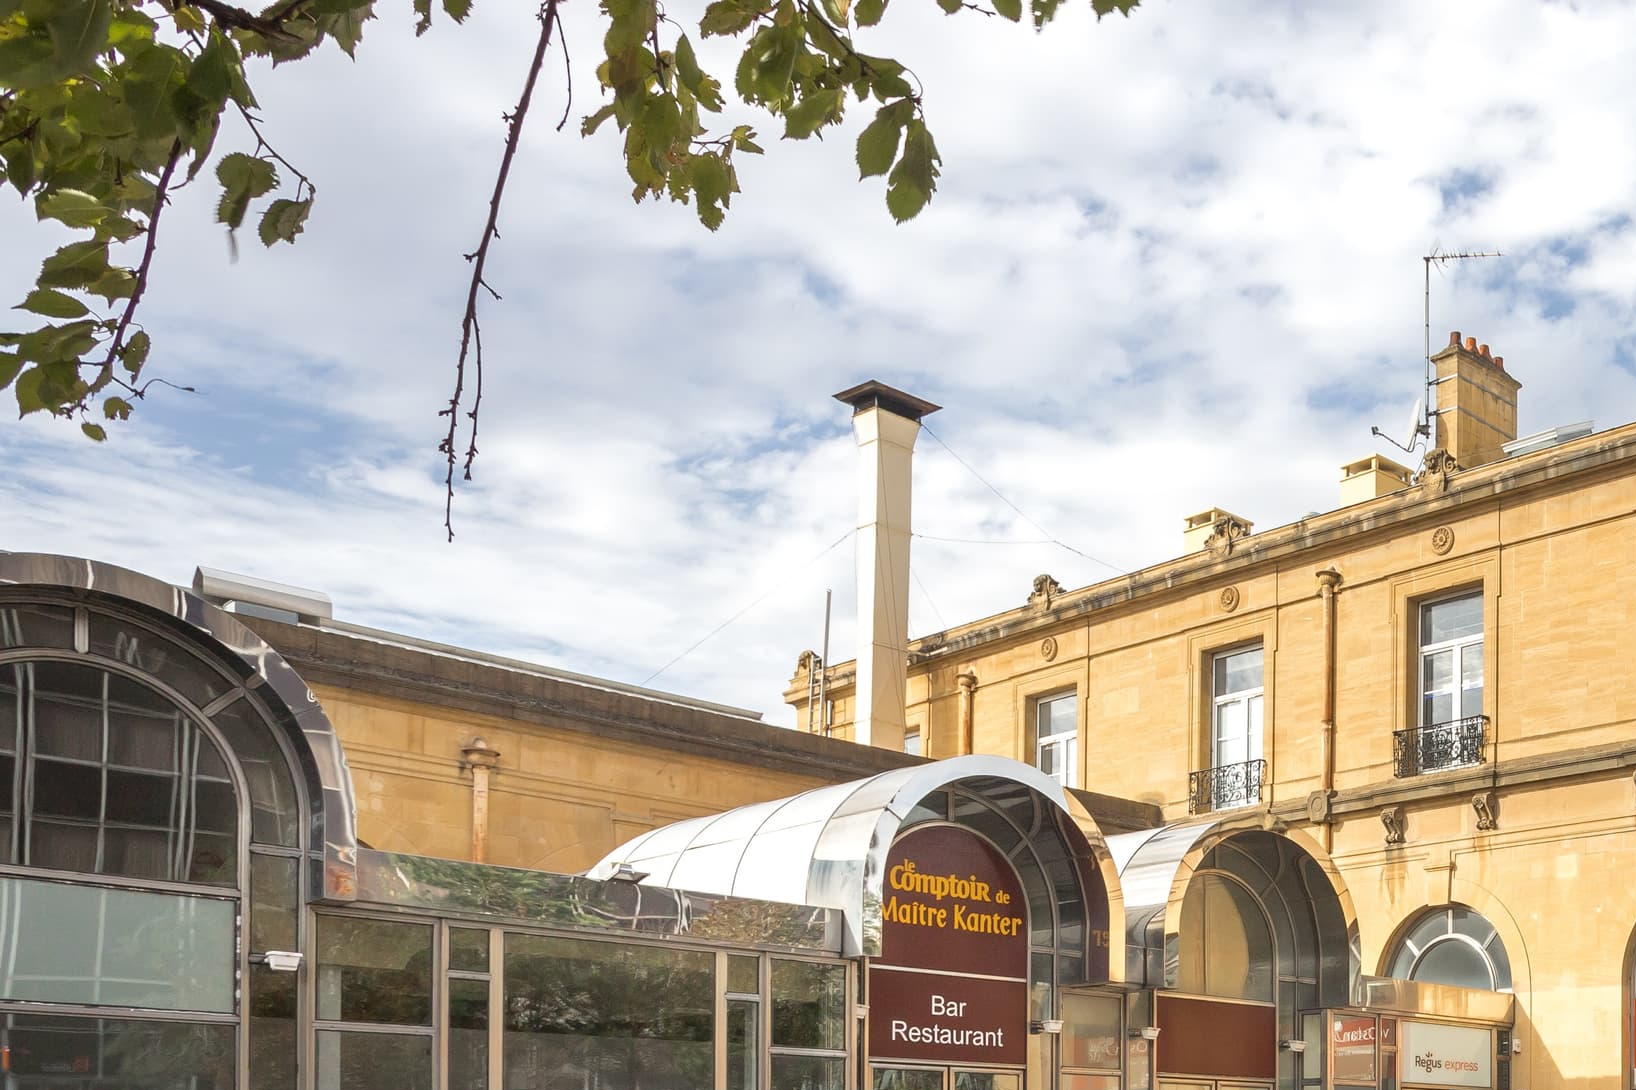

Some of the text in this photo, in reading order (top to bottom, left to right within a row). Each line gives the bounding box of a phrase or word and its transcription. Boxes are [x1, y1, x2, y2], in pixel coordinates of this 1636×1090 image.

[904, 858, 915, 872] le
[996, 890, 1010, 904] de
[881, 896, 1022, 936] Maître Kanter
[931, 995, 967, 1017] Bar
[891, 1020, 1004, 1047] Restaurant
[1415, 1055, 1478, 1073] Regus express
